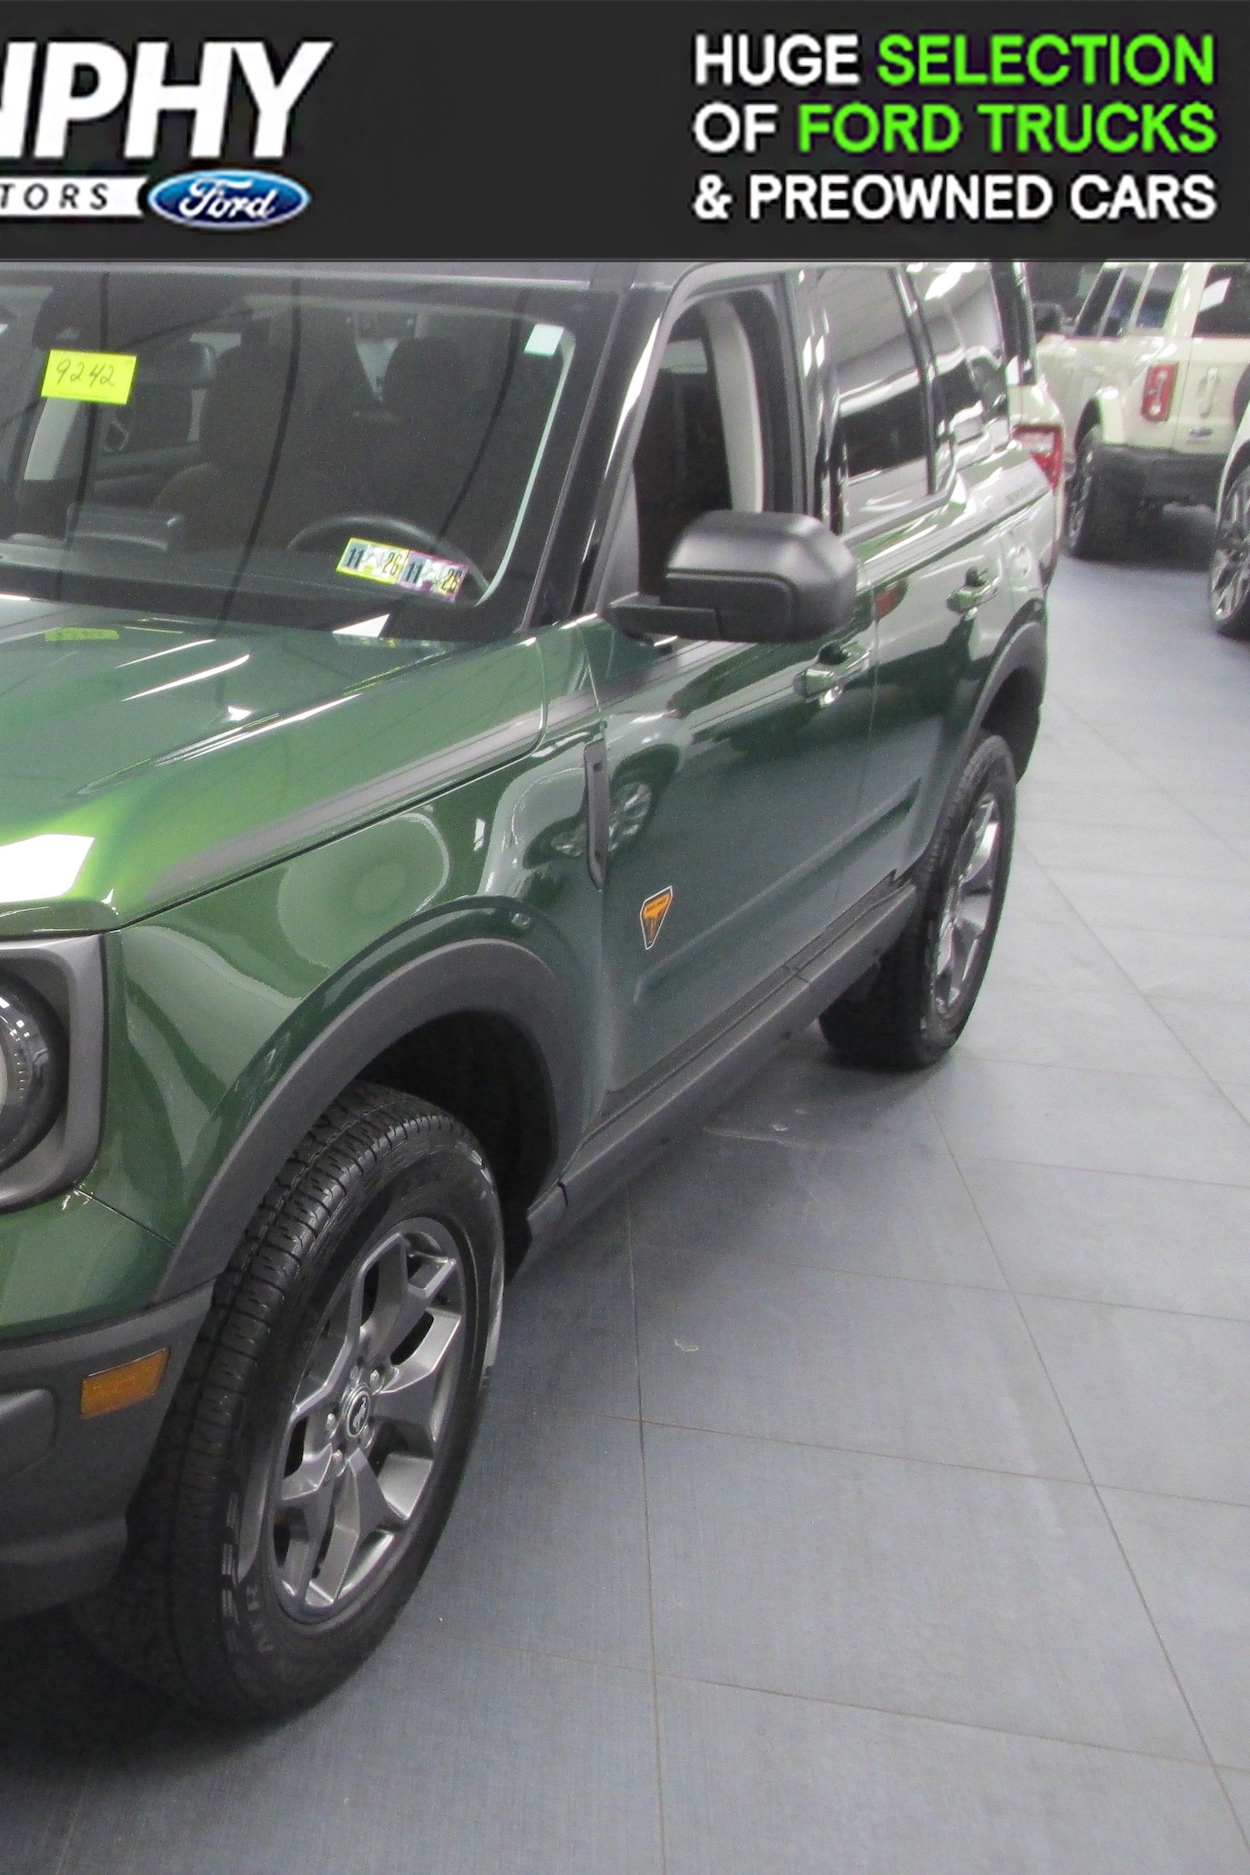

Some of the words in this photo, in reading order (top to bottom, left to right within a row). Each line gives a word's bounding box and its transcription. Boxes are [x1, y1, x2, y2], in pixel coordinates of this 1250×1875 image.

[55, 358, 115, 389] 9242
[347, 548, 364, 569] 11
[381, 552, 403, 577] 26
[405, 563, 424, 584] 11
